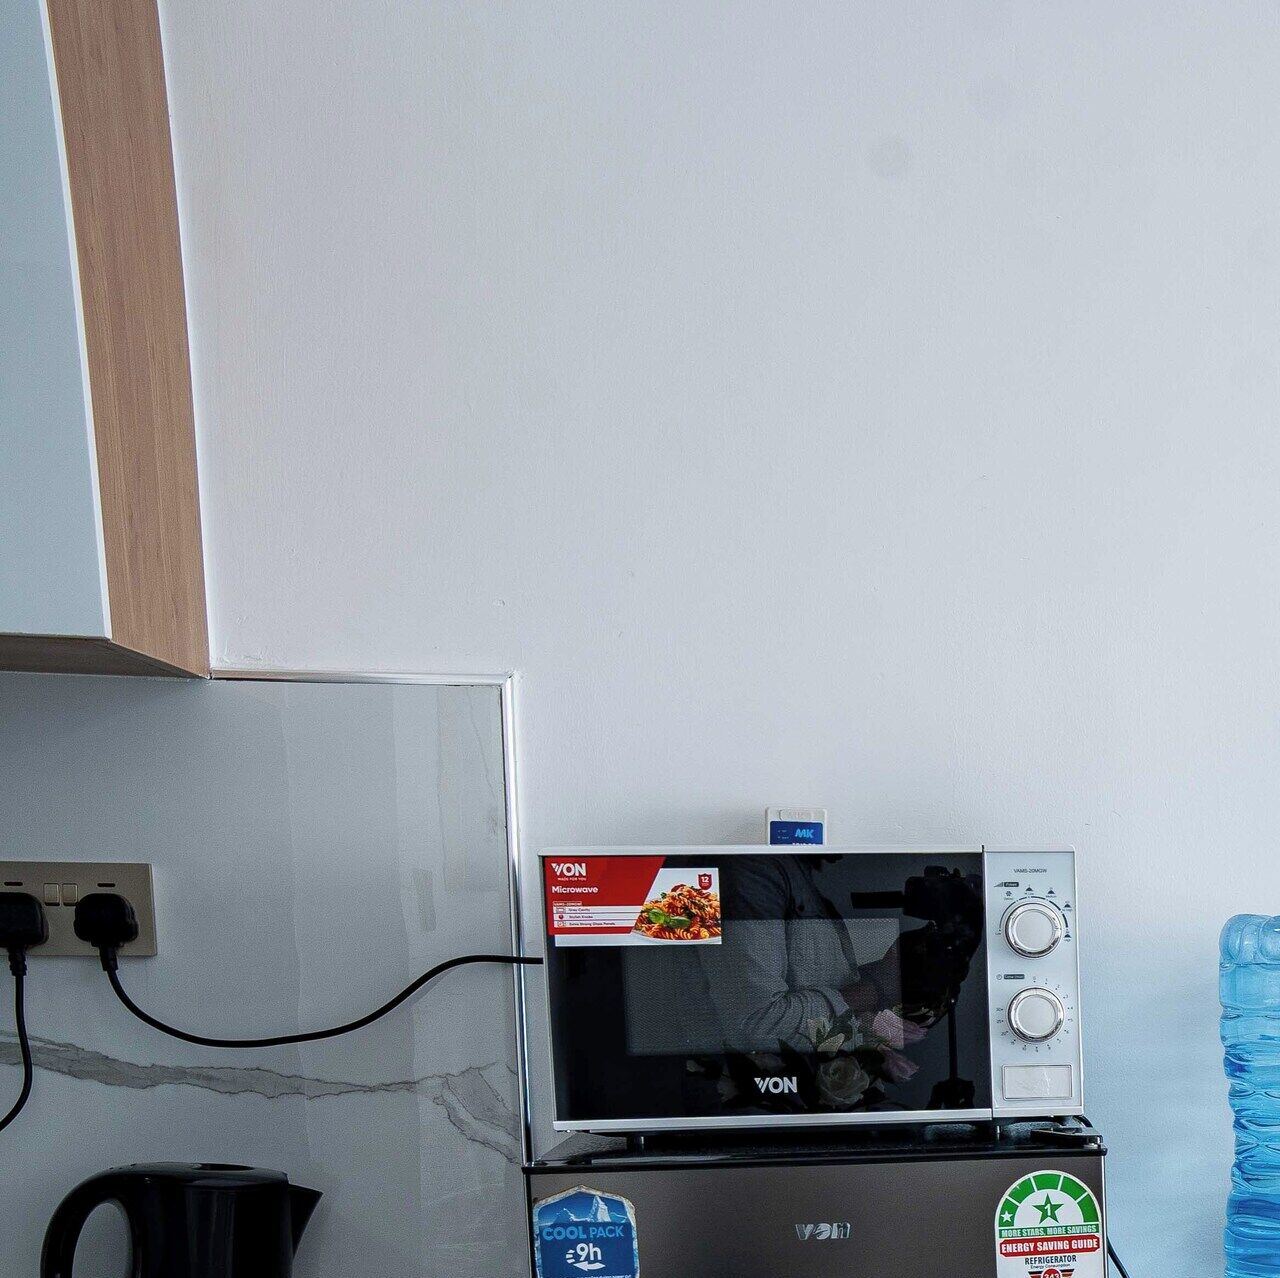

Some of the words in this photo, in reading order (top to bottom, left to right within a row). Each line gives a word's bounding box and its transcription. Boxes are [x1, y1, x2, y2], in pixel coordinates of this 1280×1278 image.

[551, 863, 586, 876] VON
[754, 1077, 797, 1093] VON
[1044, 1203, 1051, 1216] 1
[543, 1226, 587, 1241] COOL
[589, 1225, 624, 1238] PACK
[1002, 1229, 1021, 1237] MORE
[1022, 1228, 1046, 1236] STARS,
[1047, 1227, 1066, 1235] MORE
[1067, 1225, 1097, 1234] SAVINGS
[576, 1243, 602, 1261] 9h
[1001, 1243, 1034, 1253] ENERGY
[1037, 1241, 1069, 1251] SAVING
[1071, 1239, 1098, 1249] GUIDE
[1025, 1255, 1076, 1265] REFRIGERATOR
